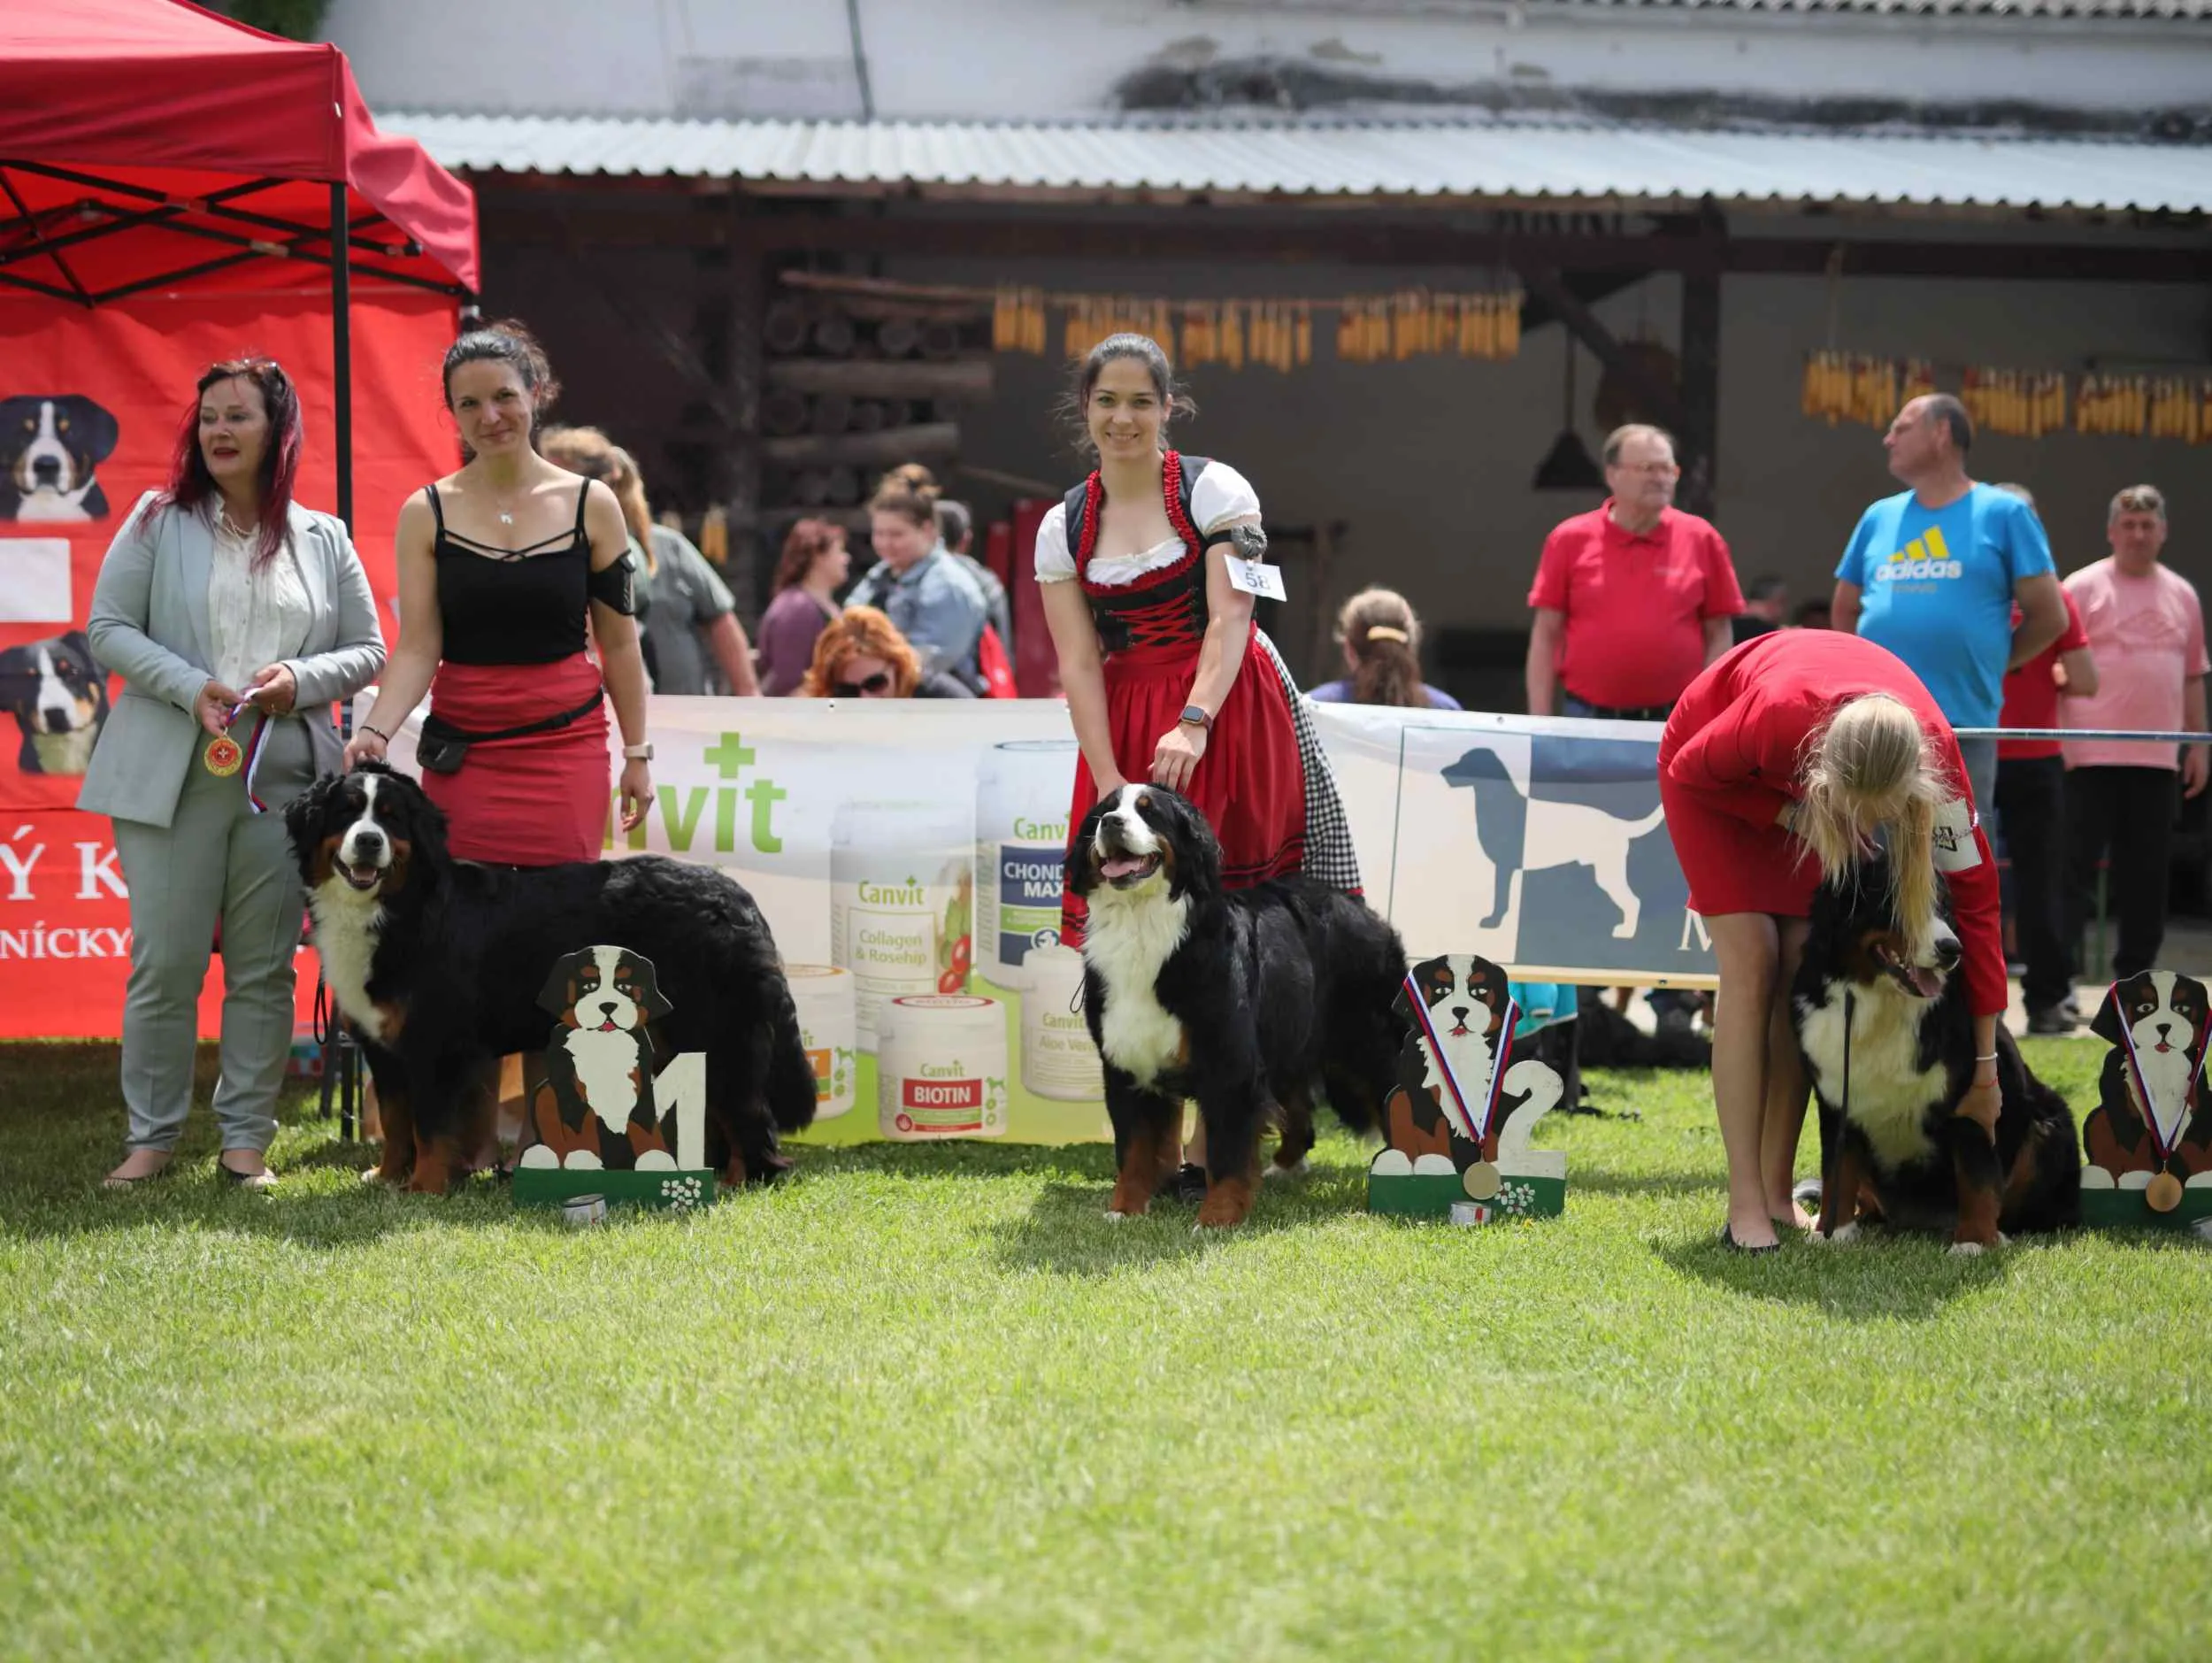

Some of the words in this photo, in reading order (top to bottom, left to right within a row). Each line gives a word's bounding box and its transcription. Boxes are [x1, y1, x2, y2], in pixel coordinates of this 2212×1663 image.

[1875, 558, 1962, 581] adidas
[1014, 812, 1069, 841] Canv
[0, 824, 45, 900] Ý
[73, 842, 129, 899] K
[858, 874, 925, 905] Canvit
[0, 920, 134, 959] NÍCKY
[859, 929, 922, 950] Collagen
[856, 946, 865, 960] &
[869, 948, 926, 966] Rosehip
[920, 1059, 966, 1078] Canvit
[914, 1086, 971, 1105] BIOTIN
[652, 1052, 707, 1169] 1
[1497, 1060, 1566, 1179] 2
